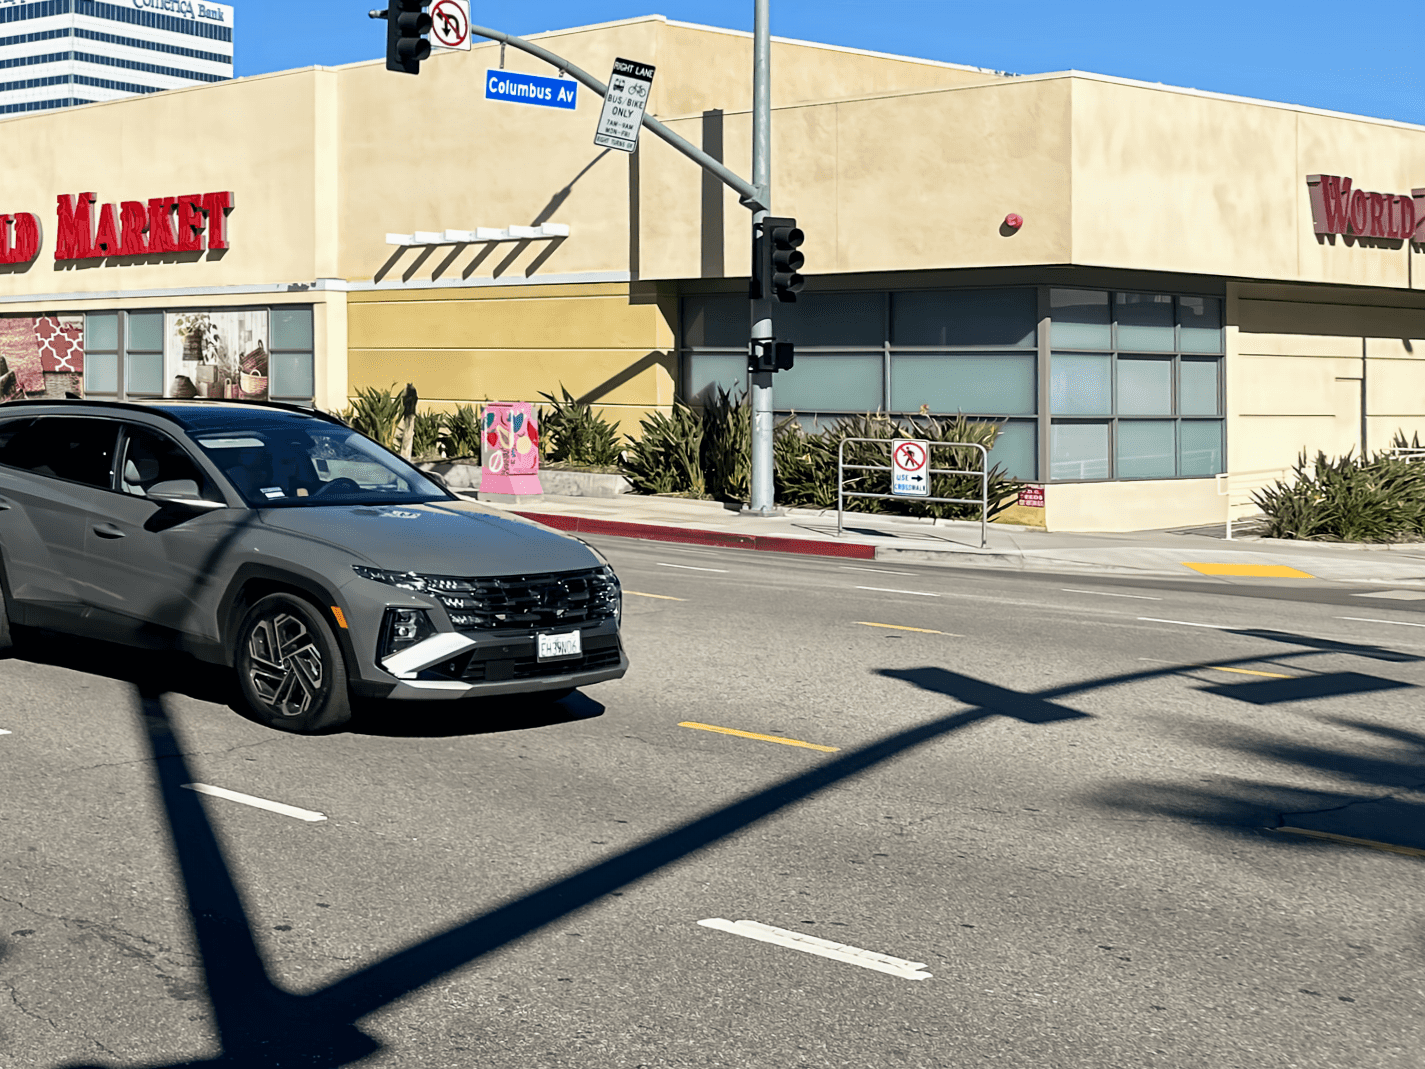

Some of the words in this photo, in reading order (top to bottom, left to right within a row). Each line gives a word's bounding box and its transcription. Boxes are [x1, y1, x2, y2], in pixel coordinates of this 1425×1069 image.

[197, 4, 225, 22] Bank
[613, 61, 634, 74] RIGHT
[635, 66, 654, 79] LANE
[488, 76, 552, 101] Columbus
[556, 86, 575, 103] Av
[607, 93, 645, 110] BUS/BIKE
[612, 106, 634, 118] ONLY
[1306, 174, 1415, 240] WORLD
[53, 191, 235, 263] MARKET
[895, 474, 909, 482] USE
[894, 483, 926, 492] CROSSWALK
